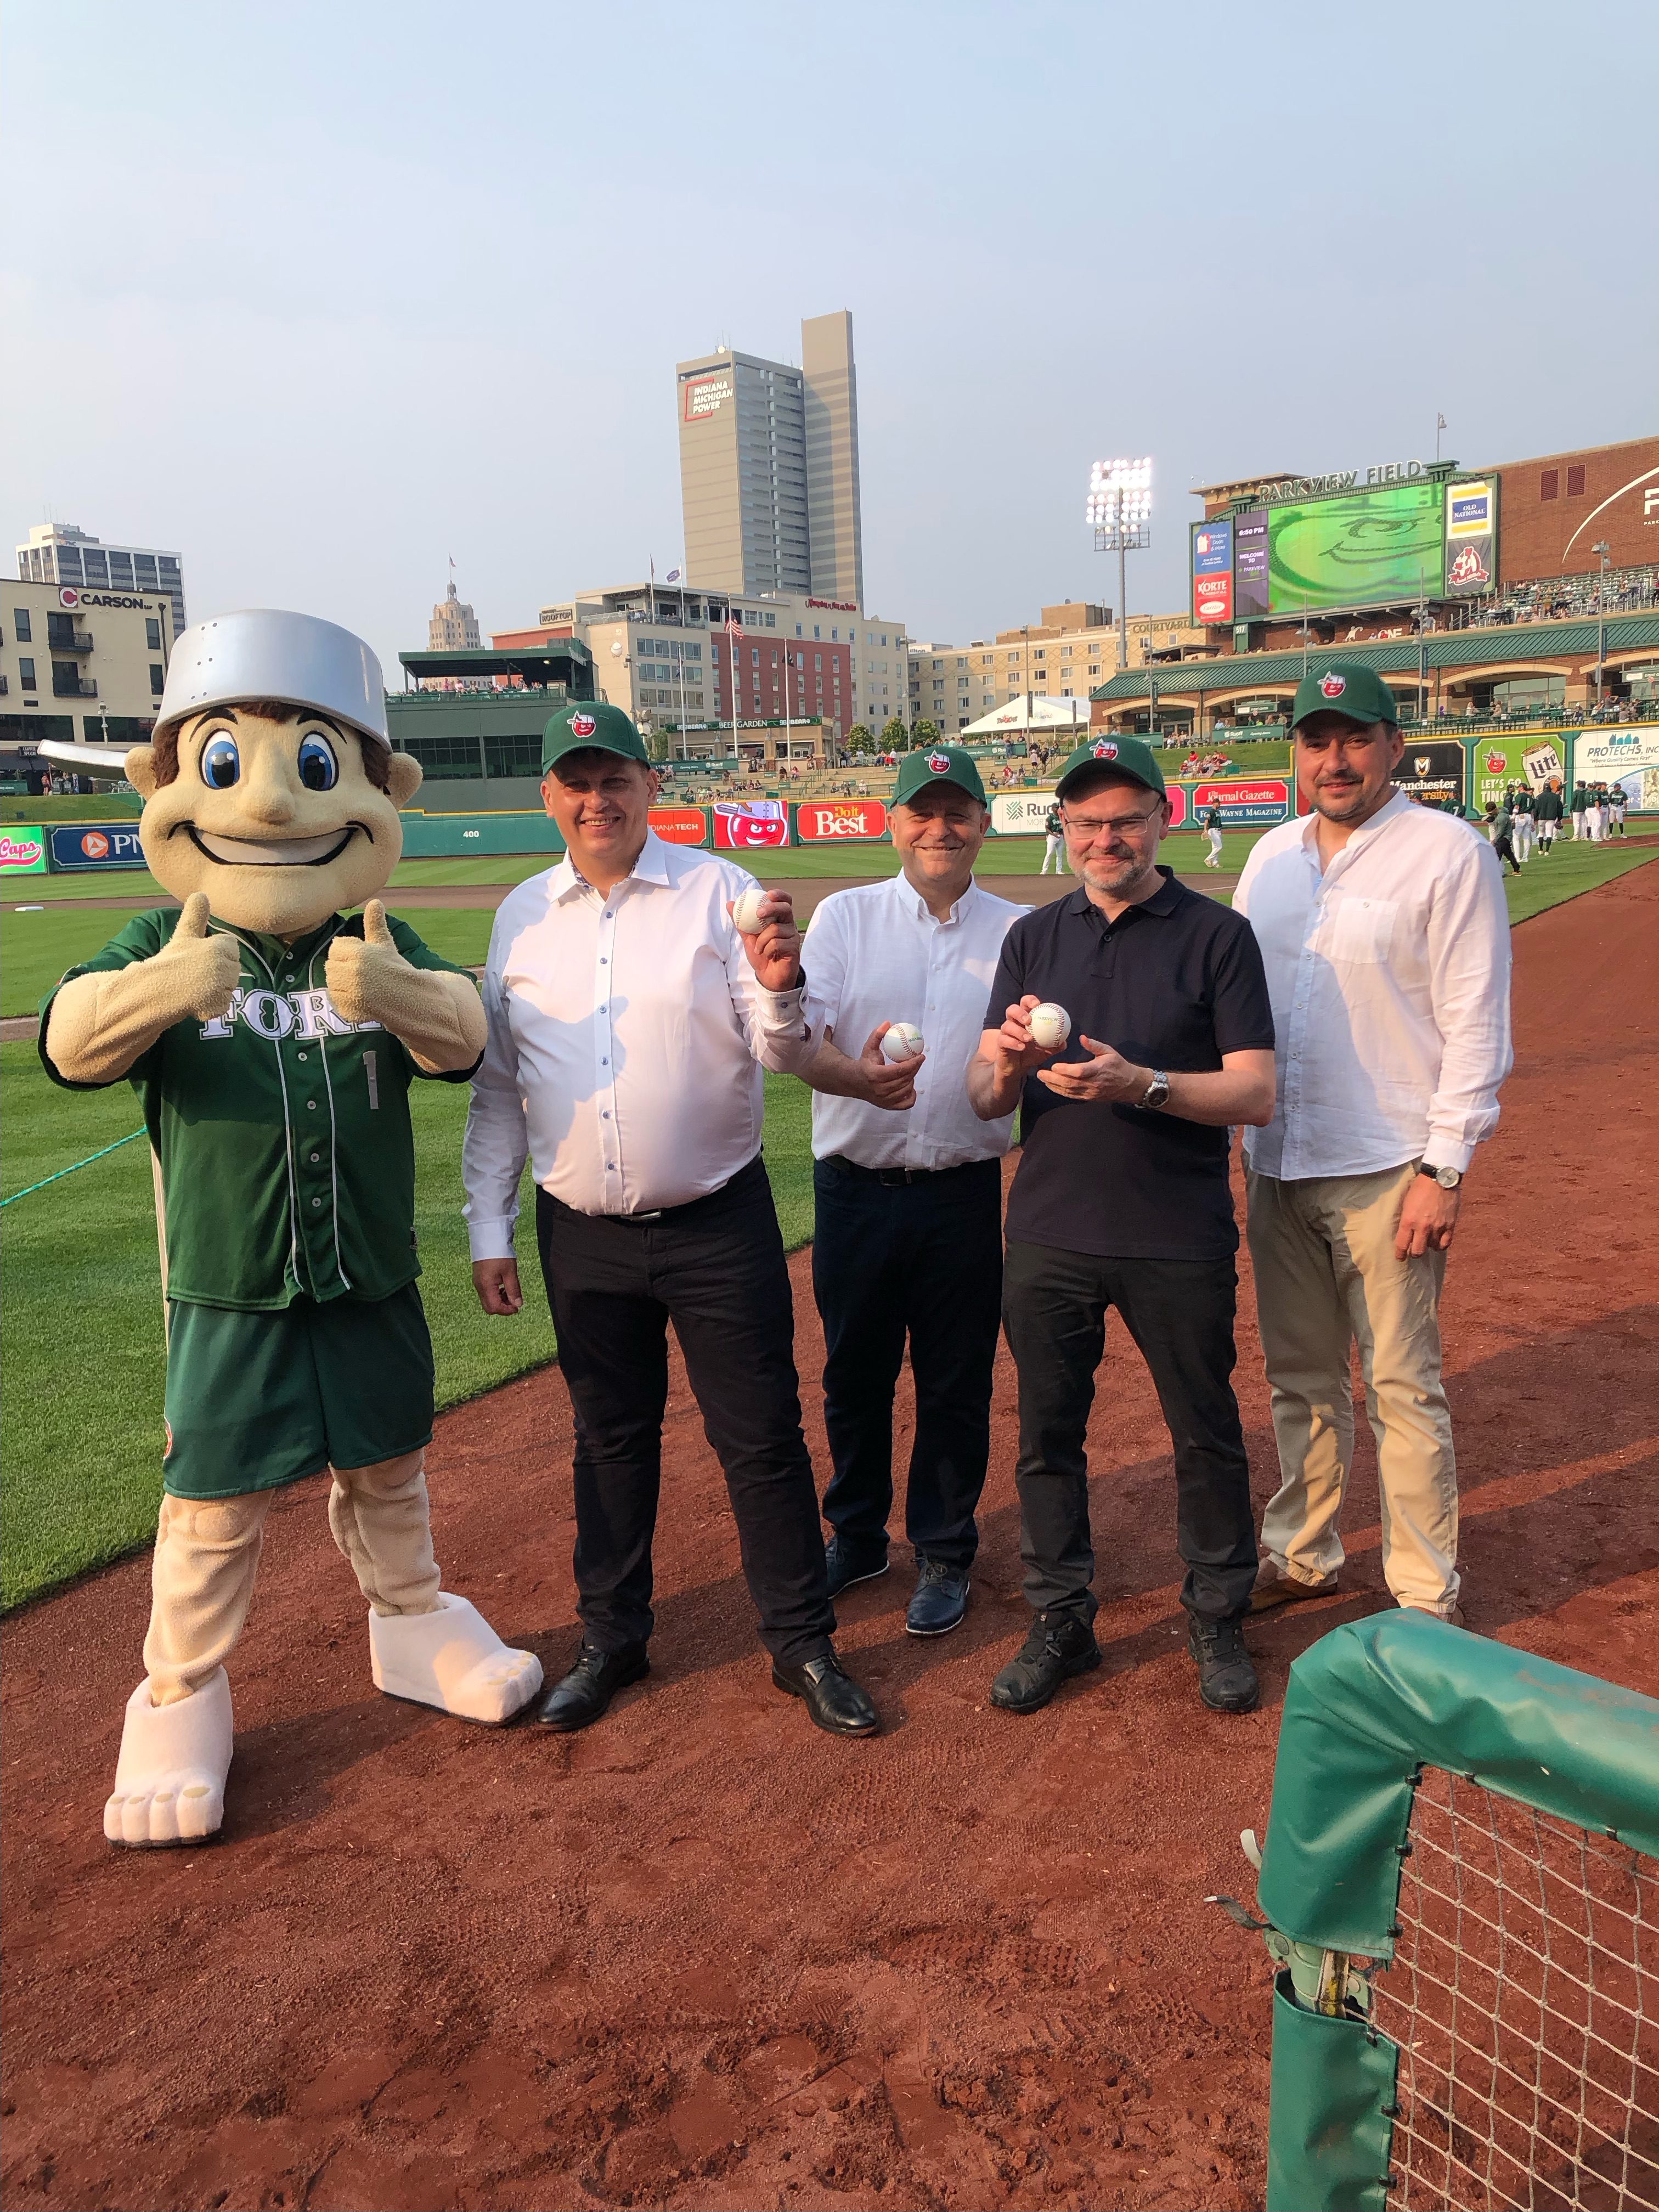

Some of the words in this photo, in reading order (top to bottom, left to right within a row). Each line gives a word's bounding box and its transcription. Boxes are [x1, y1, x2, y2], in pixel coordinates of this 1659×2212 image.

[694, 381, 728, 396] INDIANA
[693, 388, 733, 404] MICHIGAN
[693, 400, 720, 414] POWER
[1258, 469, 1360, 503] PARKVIEW
[1366, 459, 1423, 486] FIELD
[1454, 508, 1485, 518] NATIONAL
[1239, 551, 1265, 560] WELCOME
[1198, 579, 1227, 596] KORTE
[81, 594, 143, 610] CARSON
[541, 612, 571, 622] ROOFTOP
[737, 720, 768, 728] GARDEN
[1587, 745, 1643, 757] PROTECHS,
[1528, 753, 1558, 779] Lite
[1390, 779, 1457, 791] Manchester
[1481, 779, 1504, 789] LET'S
[1508, 778, 1522, 787] GO
[1206, 791, 1239, 802] Journal
[1240, 790, 1274, 801] Gazette
[834, 806, 851, 818] Do
[851, 806, 860, 817] it
[1027, 803, 1052, 816] Ruo
[1453, 806, 1459, 816] 7
[814, 811, 868, 836] Best
[111, 834, 141, 854] PN
[199, 987, 384, 1040] FOR
[363, 1050, 379, 1109] 1
